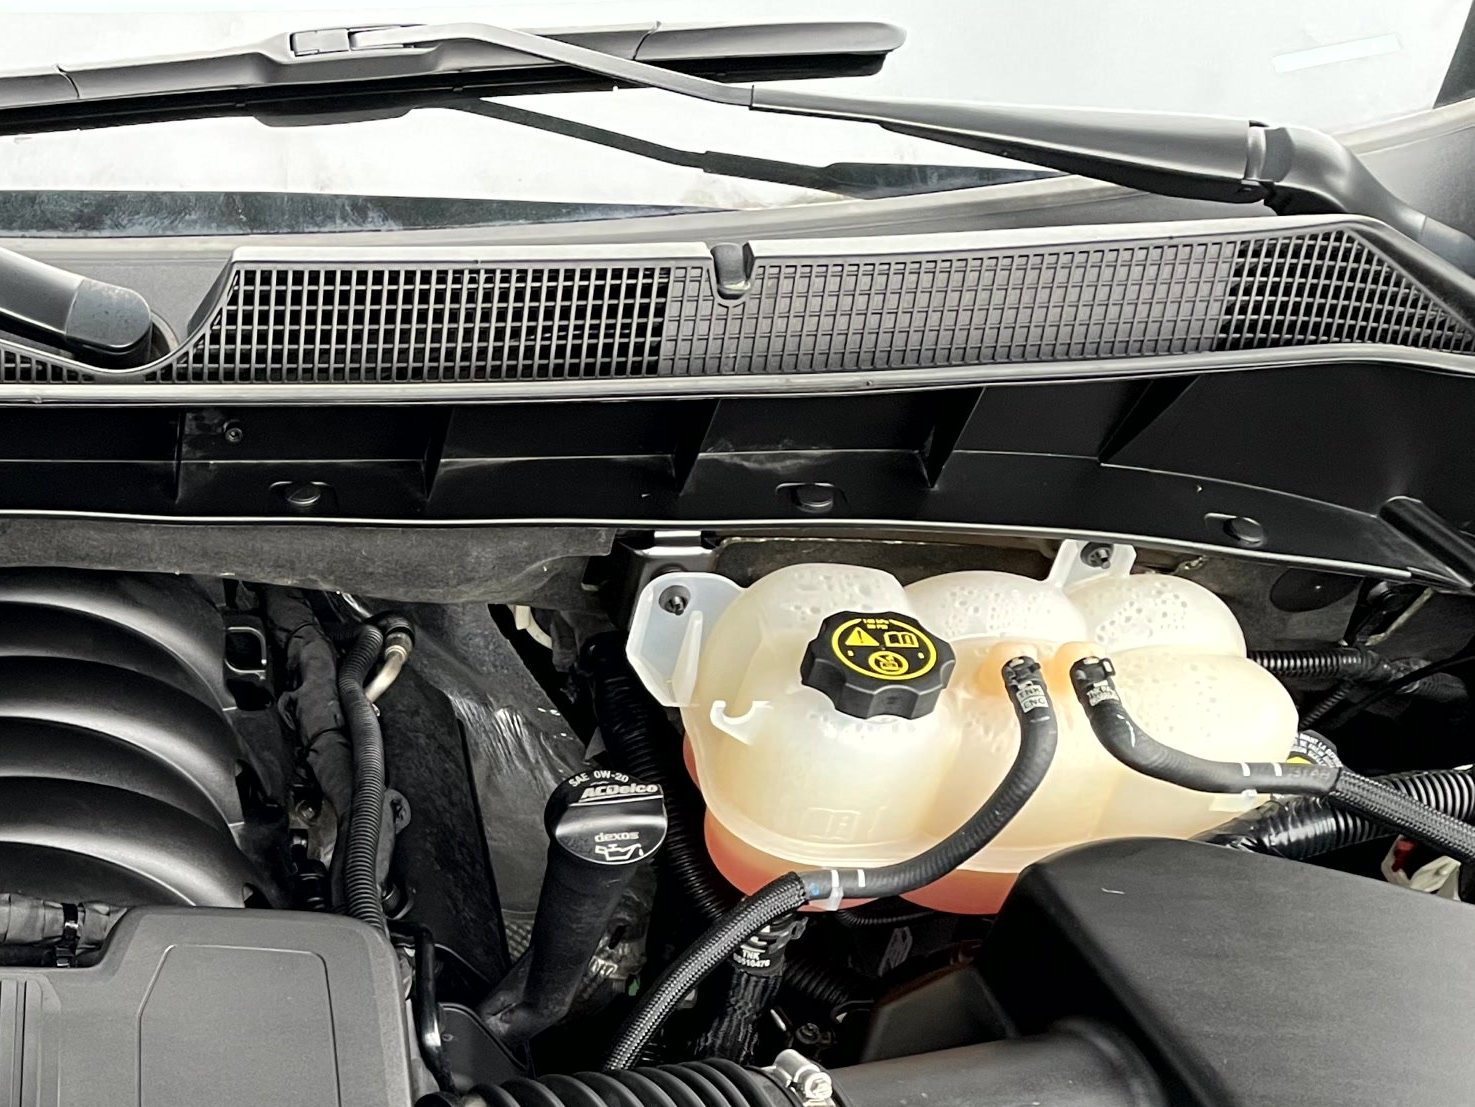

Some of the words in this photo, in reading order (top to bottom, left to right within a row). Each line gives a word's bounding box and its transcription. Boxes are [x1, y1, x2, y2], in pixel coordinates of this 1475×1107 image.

[568, 772, 590, 787] SAE
[593, 770, 629, 783] 0W-20
[581, 783, 658, 799] ACDelco
[594, 832, 640, 843] dexos
